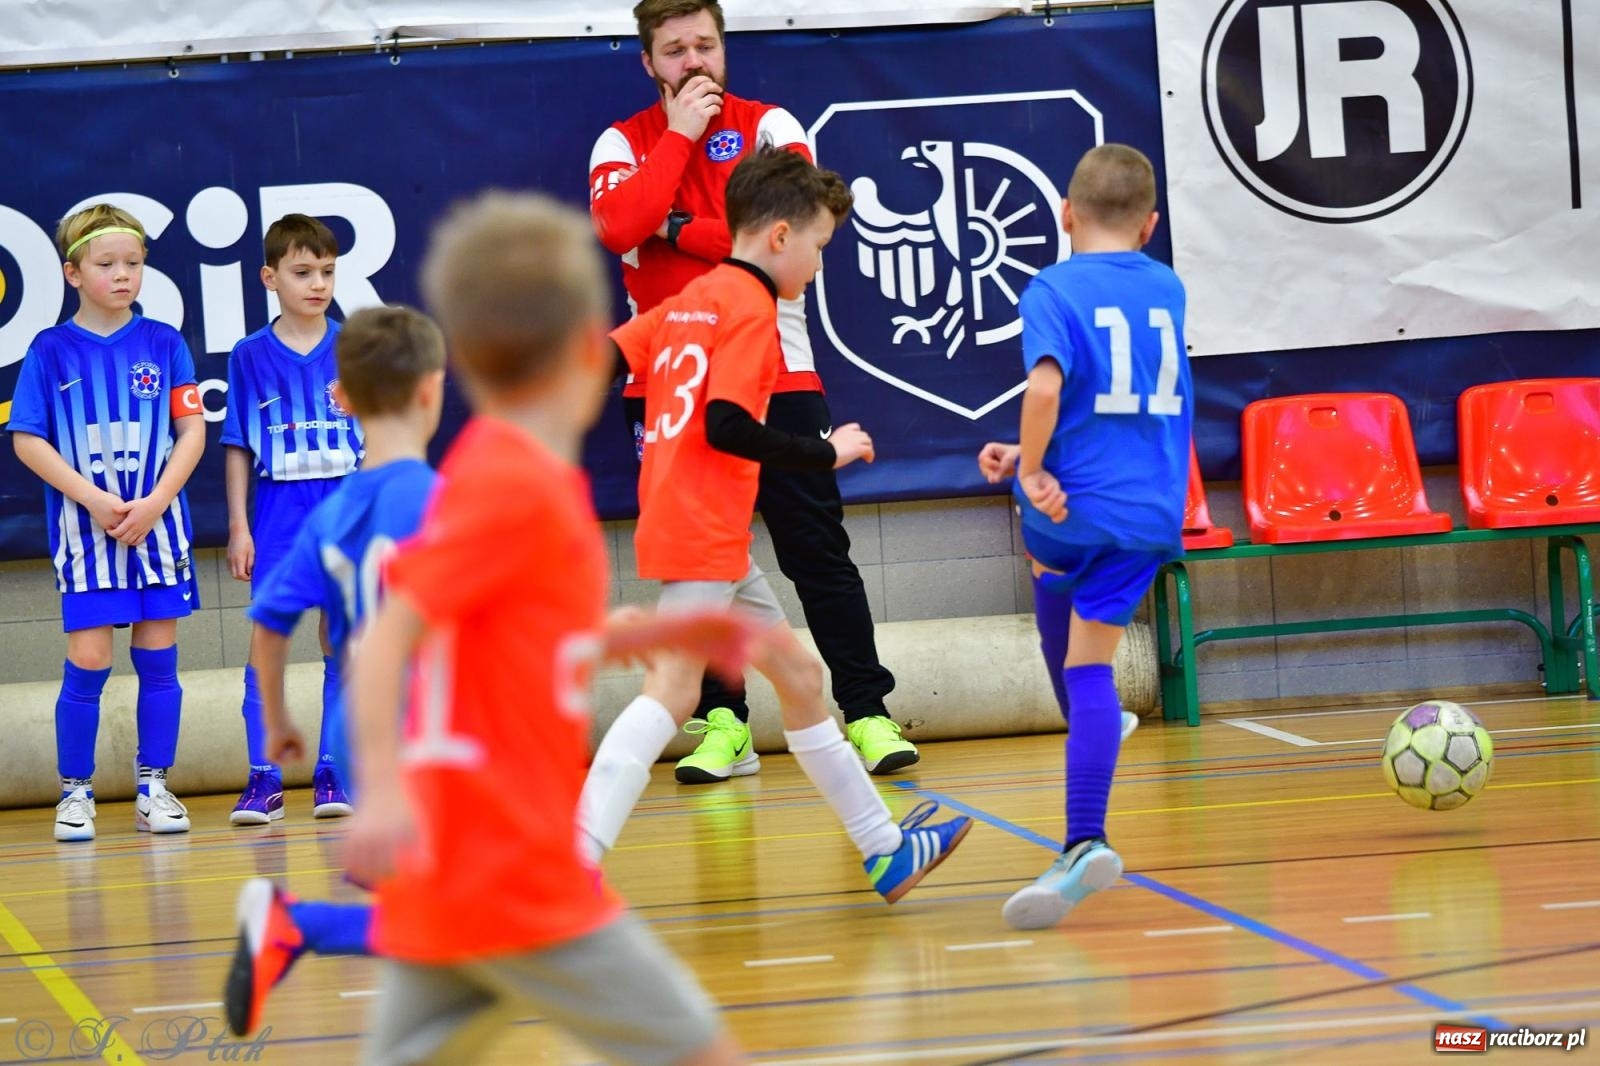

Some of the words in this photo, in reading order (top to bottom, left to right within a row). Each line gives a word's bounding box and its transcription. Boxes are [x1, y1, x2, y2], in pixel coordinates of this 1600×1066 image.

[1255, 0, 1426, 162] JR
[182, 389, 199, 409] C
[645, 343, 708, 443] 13
[1094, 306, 1183, 416] 11
